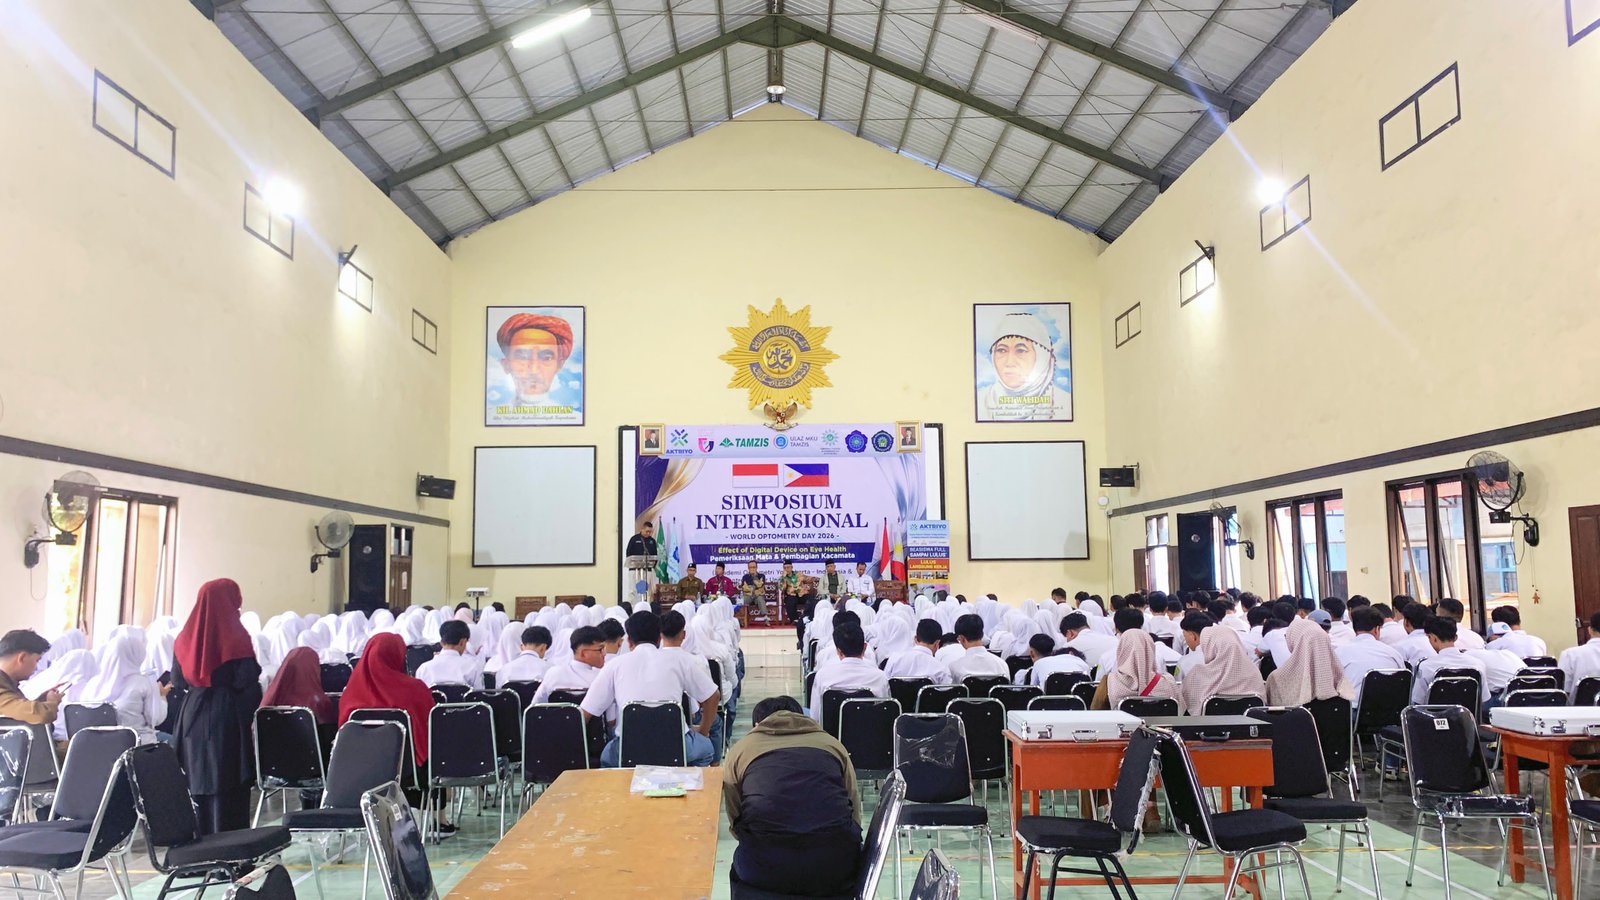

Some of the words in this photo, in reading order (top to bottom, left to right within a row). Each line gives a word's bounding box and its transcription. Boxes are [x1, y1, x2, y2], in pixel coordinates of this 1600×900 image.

[735, 438, 769, 447] TAMZIS
[722, 494, 842, 510] SIMPOSIUM
[696, 513, 868, 530] INTERNASIONAL
